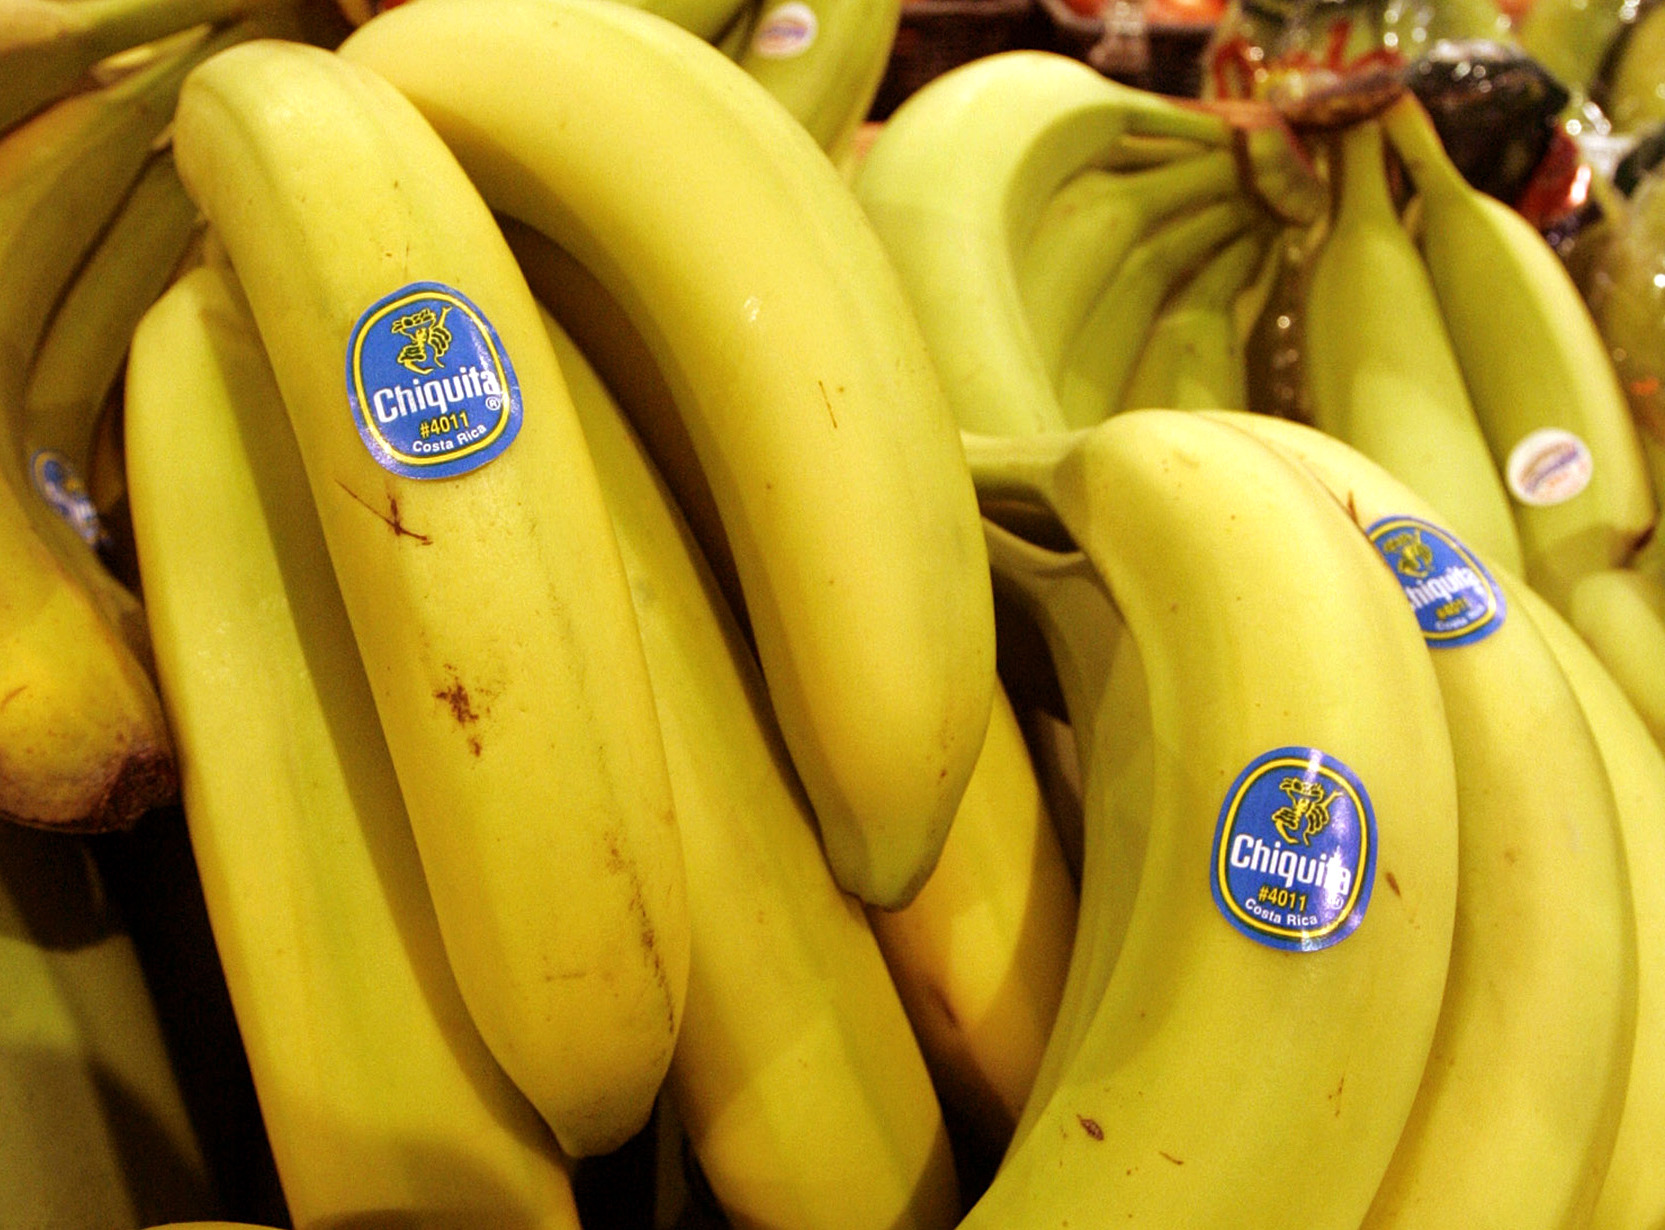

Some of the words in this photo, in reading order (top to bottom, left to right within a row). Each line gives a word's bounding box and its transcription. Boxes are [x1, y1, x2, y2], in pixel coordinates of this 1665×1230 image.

[373, 366, 501, 423] Chiquita
[413, 440, 454, 453] Costa
[456, 424, 487, 445] Rica
[420, 411, 469, 438] #4011
[1404, 565, 1481, 611] hiquita
[1245, 898, 1281, 924] Costa
[1286, 914, 1318, 926] Rica
[1258, 885, 1307, 912] #4011
